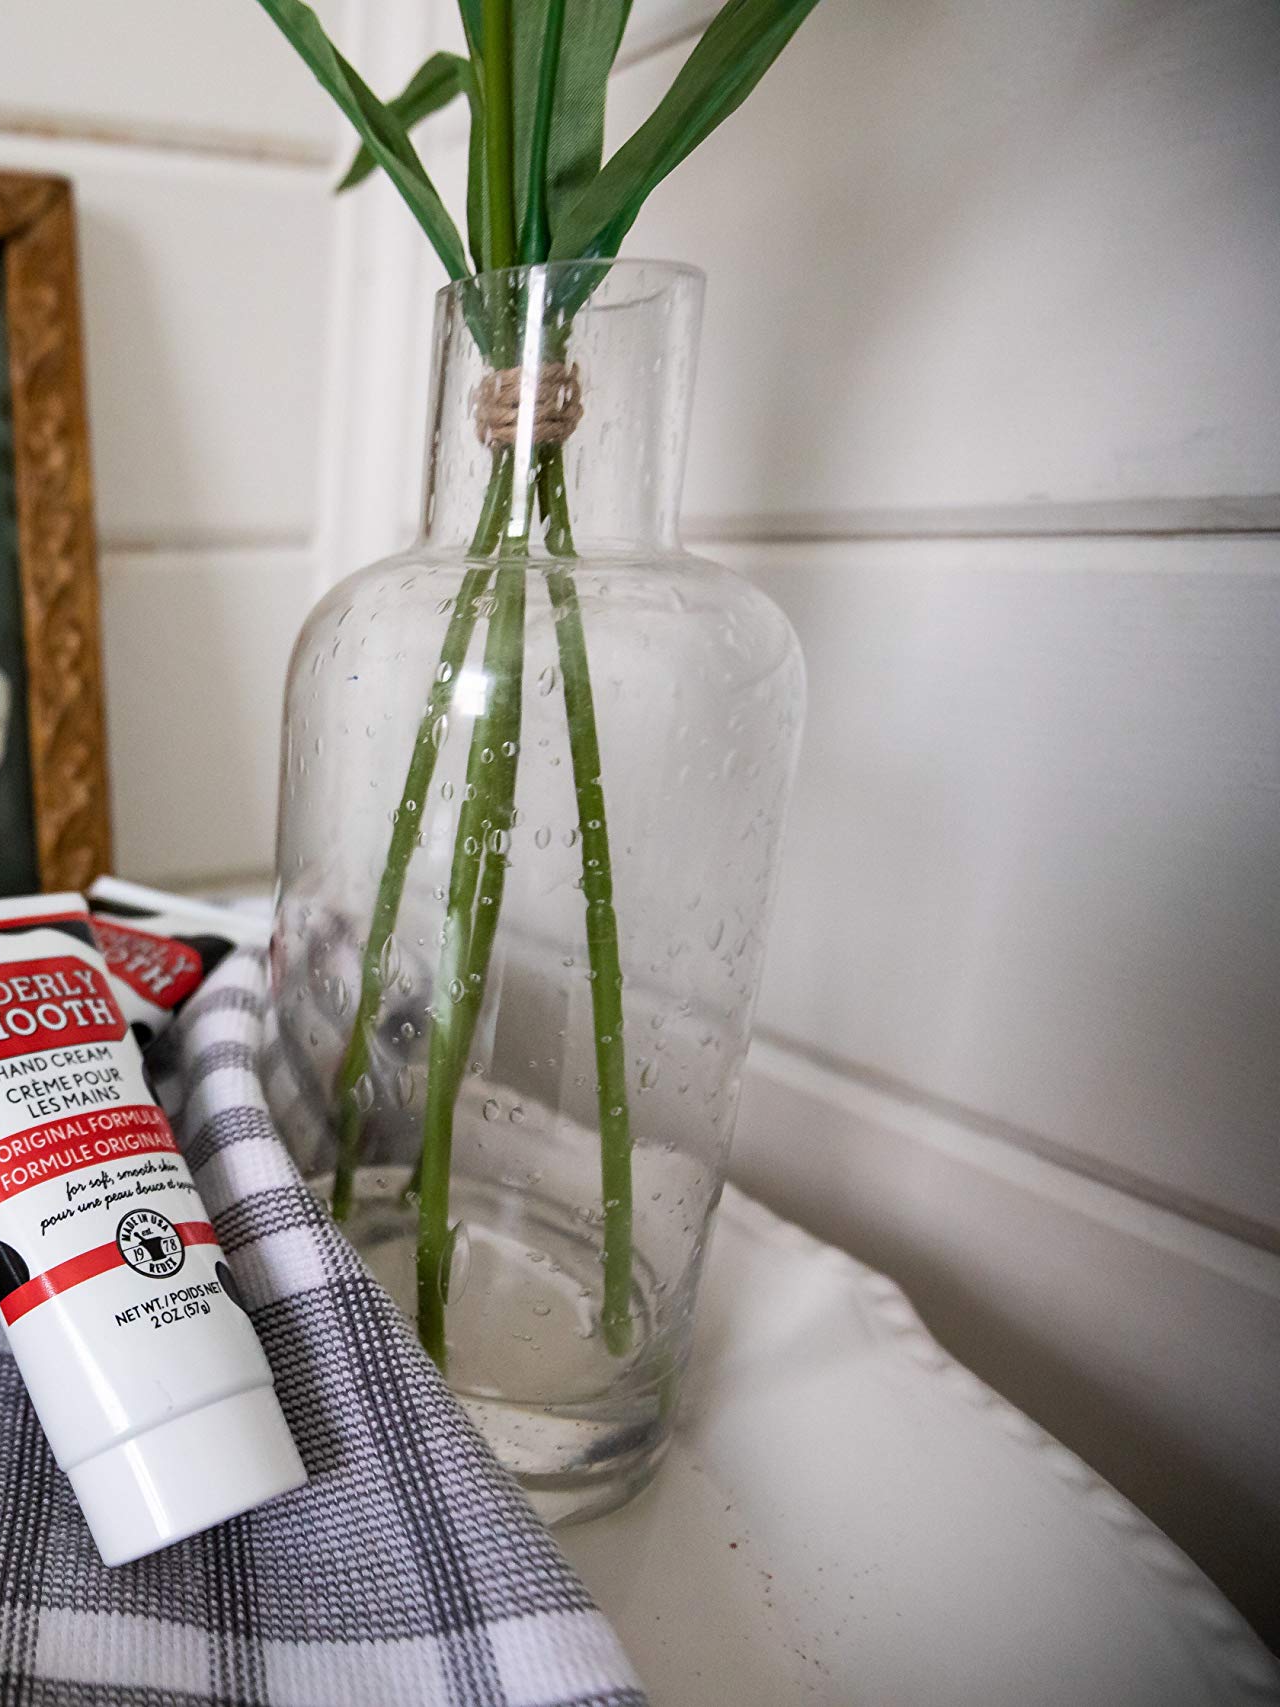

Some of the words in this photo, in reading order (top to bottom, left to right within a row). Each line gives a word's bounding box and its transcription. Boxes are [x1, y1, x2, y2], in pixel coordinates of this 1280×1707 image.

[51, 1046, 113, 1067] CREAM
[6, 1075, 73, 1104] CRÈME
[73, 1067, 123, 1088] POUR
[27, 1097, 61, 1118] LES
[62, 1085, 121, 1109] MAINS
[87, 1110, 162, 1133] FORMULA
[0, 1144, 94, 1193] FORMULE
[94, 1132, 176, 1156] ORIGINALE
[66, 1181, 86, 1201] for
[89, 1171, 115, 1189] soft,
[117, 1160, 157, 1180] smooth
[41, 1209, 75, 1236] pour
[78, 1198, 102, 1213] une
[104, 1189, 134, 1210] peau
[136, 1181, 166, 1195] douce
[121, 1217, 139, 1242] MADE
[137, 1214, 148, 1224] IN
[151, 1215, 169, 1232] USA
[133, 1247, 144, 1262] 19
[163, 1238, 177, 1252] 78
[150, 1257, 177, 1273] REDEX
[115, 1306, 141, 1327] NET
[140, 1298, 164, 1314] WT.
[169, 1285, 205, 1304] POIDS
[151, 1316, 161, 1329] 2
